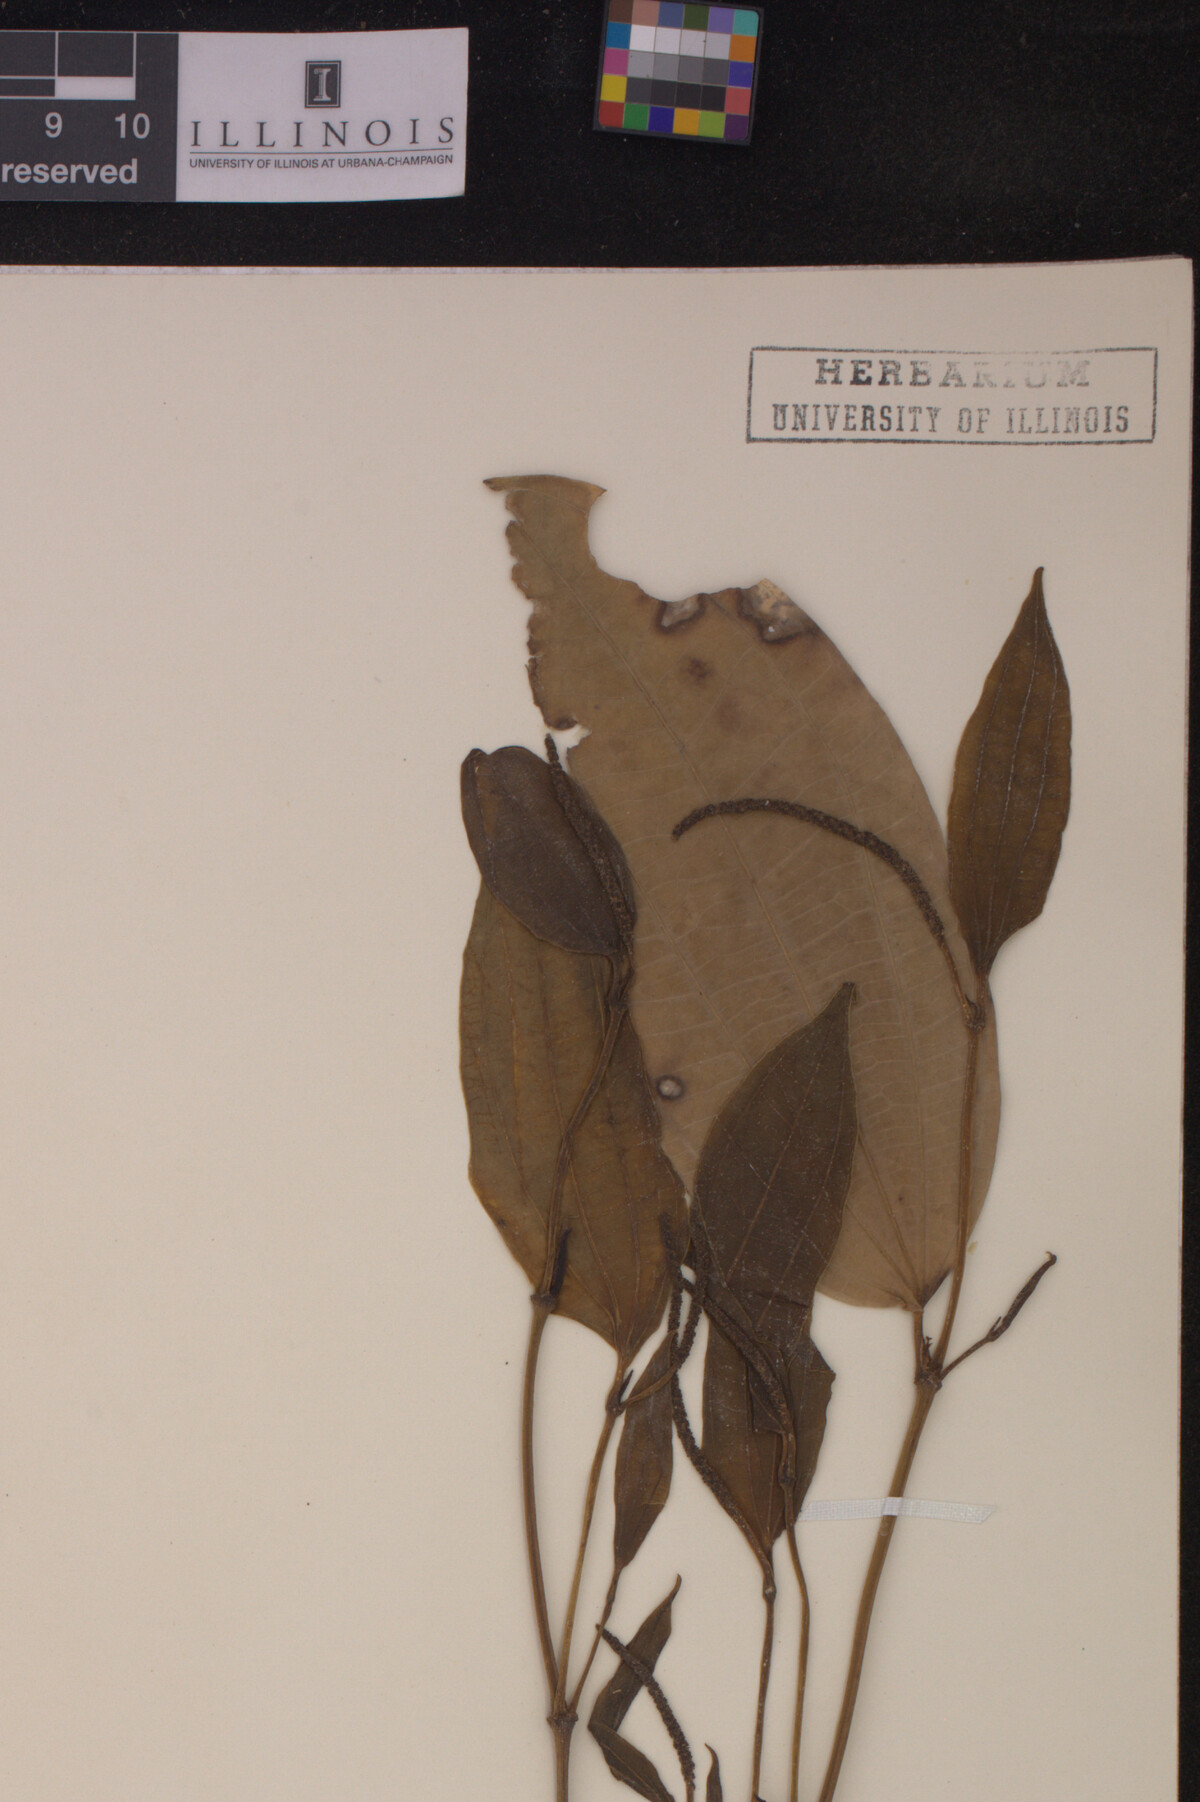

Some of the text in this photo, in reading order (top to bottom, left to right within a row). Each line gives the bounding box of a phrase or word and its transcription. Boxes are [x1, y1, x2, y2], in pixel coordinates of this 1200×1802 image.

[44, 112, 63, 138] 9
[115, 112, 150, 139] 10
[190, 116, 454, 147] ILLINOIS
[2, 158, 137, 184] reserved
[190, 154, 453, 169] UNIVERSITY OF ILLINOIS AT URBANA-CHAMPAIGN
[815, 358, 1090, 388] HERBARIUM
[773, 404, 1129, 434] UNIVERSITY OF ILLINOIS
